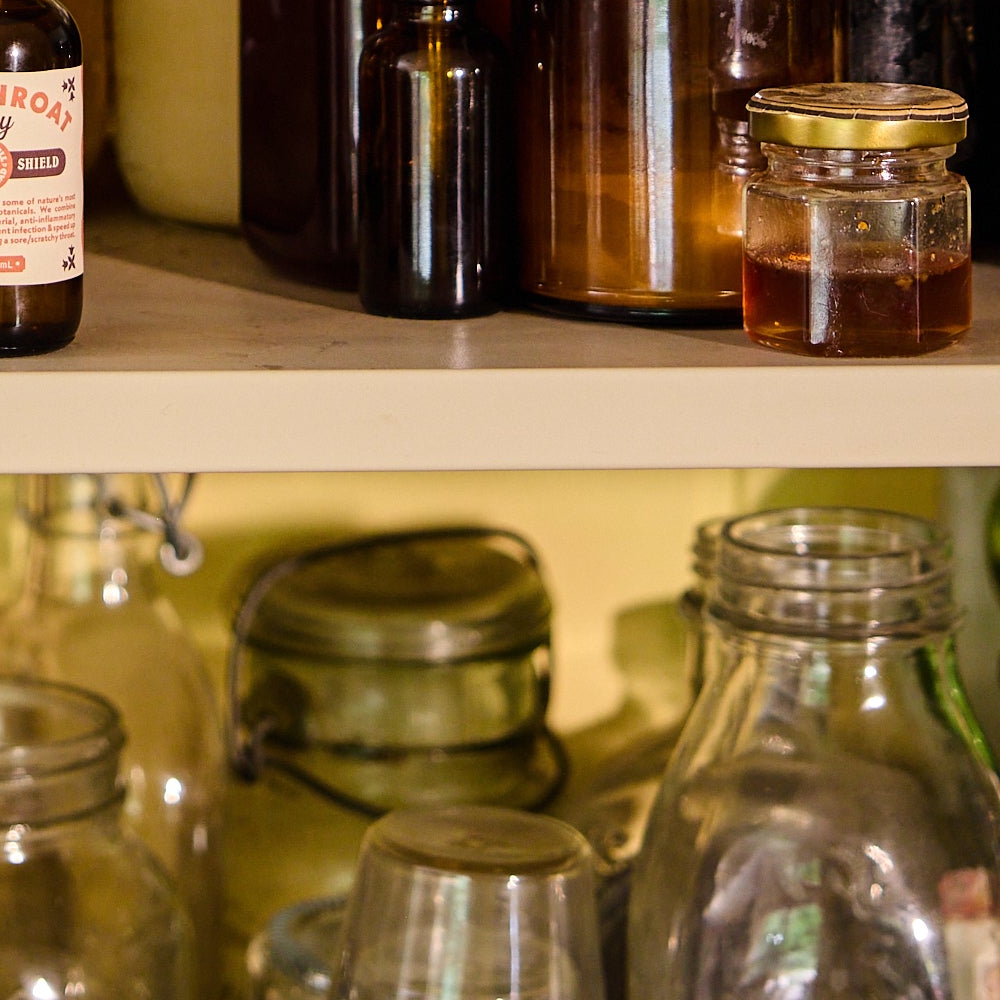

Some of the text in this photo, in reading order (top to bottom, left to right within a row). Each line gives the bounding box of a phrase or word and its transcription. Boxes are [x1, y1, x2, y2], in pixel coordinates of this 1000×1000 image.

[17, 156, 59, 170] SHIELD
[38, 194, 63, 204] nature's
[55, 203, 75, 212] combine
[20, 213, 75, 224] anti-inflammatory
[54, 222, 69, 233] speed
[11, 234, 58, 244] sore/scratchy
[0, 260, 13, 269] mL
